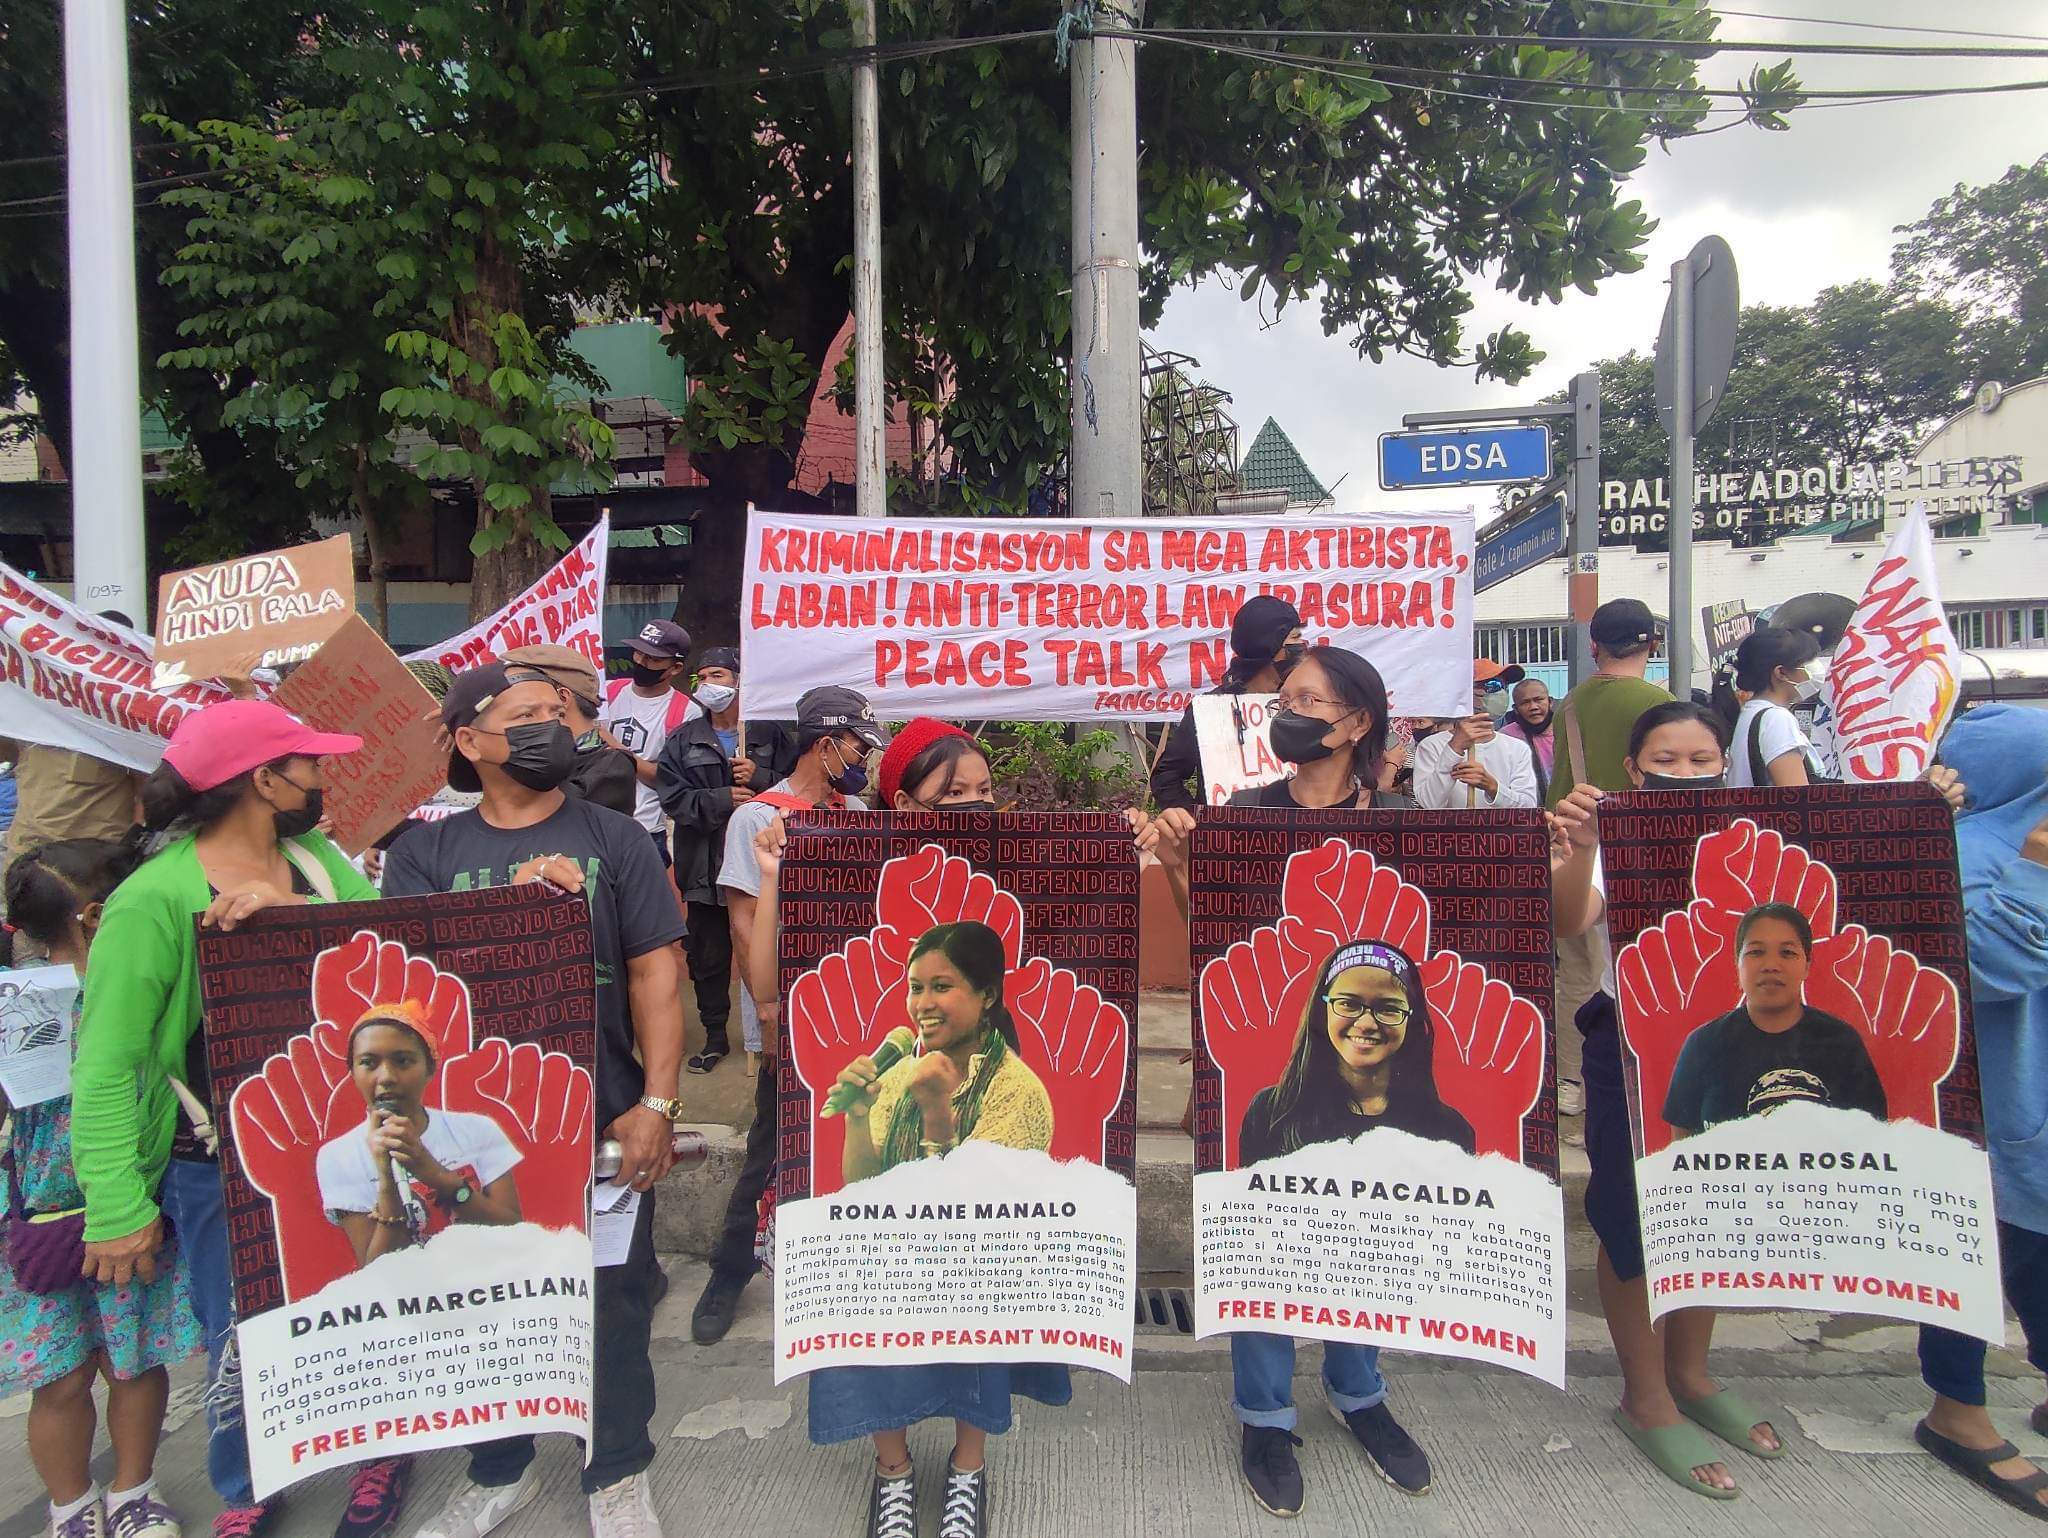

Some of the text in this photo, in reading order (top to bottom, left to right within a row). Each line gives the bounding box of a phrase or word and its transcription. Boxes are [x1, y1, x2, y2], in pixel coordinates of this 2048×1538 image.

[1421, 443, 1507, 472] EDSA
[1716, 506, 1752, 531] OF
[1764, 502, 1822, 528] THE
[759, 526, 1468, 574] KRIMINALISASYON SA MGA AKTIBISTA,
[1476, 554, 1497, 578] Gate
[1500, 544, 1505, 567] 2
[1541, 527, 1556, 547] Ave
[86, 584, 124, 599] 1097
[167, 555, 300, 614] AYUDA
[163, 602, 253, 646] HINDI
[262, 588, 345, 624] BALA
[751, 577, 1456, 631] LABAN! ANTI-TERROR LAW ASURA!
[875, 638, 1032, 688] PEACE
[1043, 640, 1168, 690] TALK
[1230, 702, 1264, 728] NO
[890, 811, 991, 832] RIGHTS
[1600, 806, 1950, 841] HUMAN DEFENDER
[784, 835, 1137, 864] HUMAN DEFENDER
[1192, 830, 1548, 857] HUMAN DEFENDER
[201, 900, 588, 967] HUMAN DEFENDER
[1672, 1152, 1898, 1172] ANDREA ROSAL
[1248, 1173, 1495, 1209] ALEXA PACALDA
[1644, 1181, 1977, 1208] Andrea Rosal ay isang human rights
[830, 1202, 1077, 1220] RONA JANE MANALO
[1202, 1200, 1551, 1242] Si Alexa Pacalda ay mula sa hanay ng mga
[1706, 1198, 1746, 1209] mula
[1767, 1200, 1784, 1209] sa
[1805, 1197, 1858, 1214] hanay
[1881, 1204, 1904, 1217] ng
[1931, 1212, 1978, 1227] mga
[785, 1229, 1125, 1248] Si Rona Jane Manalo ay isang martir ng sambayanan.
[1202, 1214, 1272, 1228] magsasaka
[1308, 1217, 1360, 1231] Quezon.
[1370, 1222, 1433, 1241] Masikhay
[1472, 1231, 1551, 1260] kabataang
[1202, 1225, 1551, 1274] aktibista at tagapagtaguyod ng karapatang
[1726, 1233, 1746, 1245] ng
[1755, 1233, 1885, 1250] gawa-gawang
[1898, 1238, 1948, 1255] kaso
[1962, 1253, 1983, 1264] at
[1735, 1217, 1753, 1226] sa
[1779, 1214, 1848, 1228] Quezon.
[1878, 1217, 1920, 1235] Siya
[1957, 1234, 1980, 1247] ay
[1696, 1247, 1759, 1261] habang
[1767, 1246, 1826, 1260] buntis.
[290, 1277, 589, 1338] DANA MARCELLANA
[1653, 1271, 1961, 1311] FREE PEASANT WOMEN
[259, 1364, 276, 1379] Si
[295, 1350, 346, 1369] Dana
[362, 1328, 465, 1352] Marcellana
[479, 1323, 499, 1336] ay
[512, 1317, 558, 1332] isang
[785, 1328, 1123, 1360] JUSTICE FOR PEASANT WOMEN
[1218, 1300, 1537, 1361] FREE PEASANT WOMEN
[261, 1374, 323, 1400] rights
[334, 1353, 416, 1377] defender
[426, 1342, 469, 1359] mula
[479, 1341, 497, 1351] sa
[506, 1334, 557, 1349] hanay
[566, 1336, 580, 1349] ng
[261, 1377, 387, 1416] magsasaka.
[398, 1369, 435, 1385] Siya
[446, 1363, 466, 1376] ay
[476, 1351, 524, 1371] ilegal
[535, 1353, 553, 1362] na
[264, 1419, 286, 1436] at
[295, 1387, 416, 1425] sinampahan
[426, 1385, 446, 1398] ng
[454, 1373, 575, 1396] gawa-gawang
[290, 1395, 588, 1465] FREE PEASANT WOME
